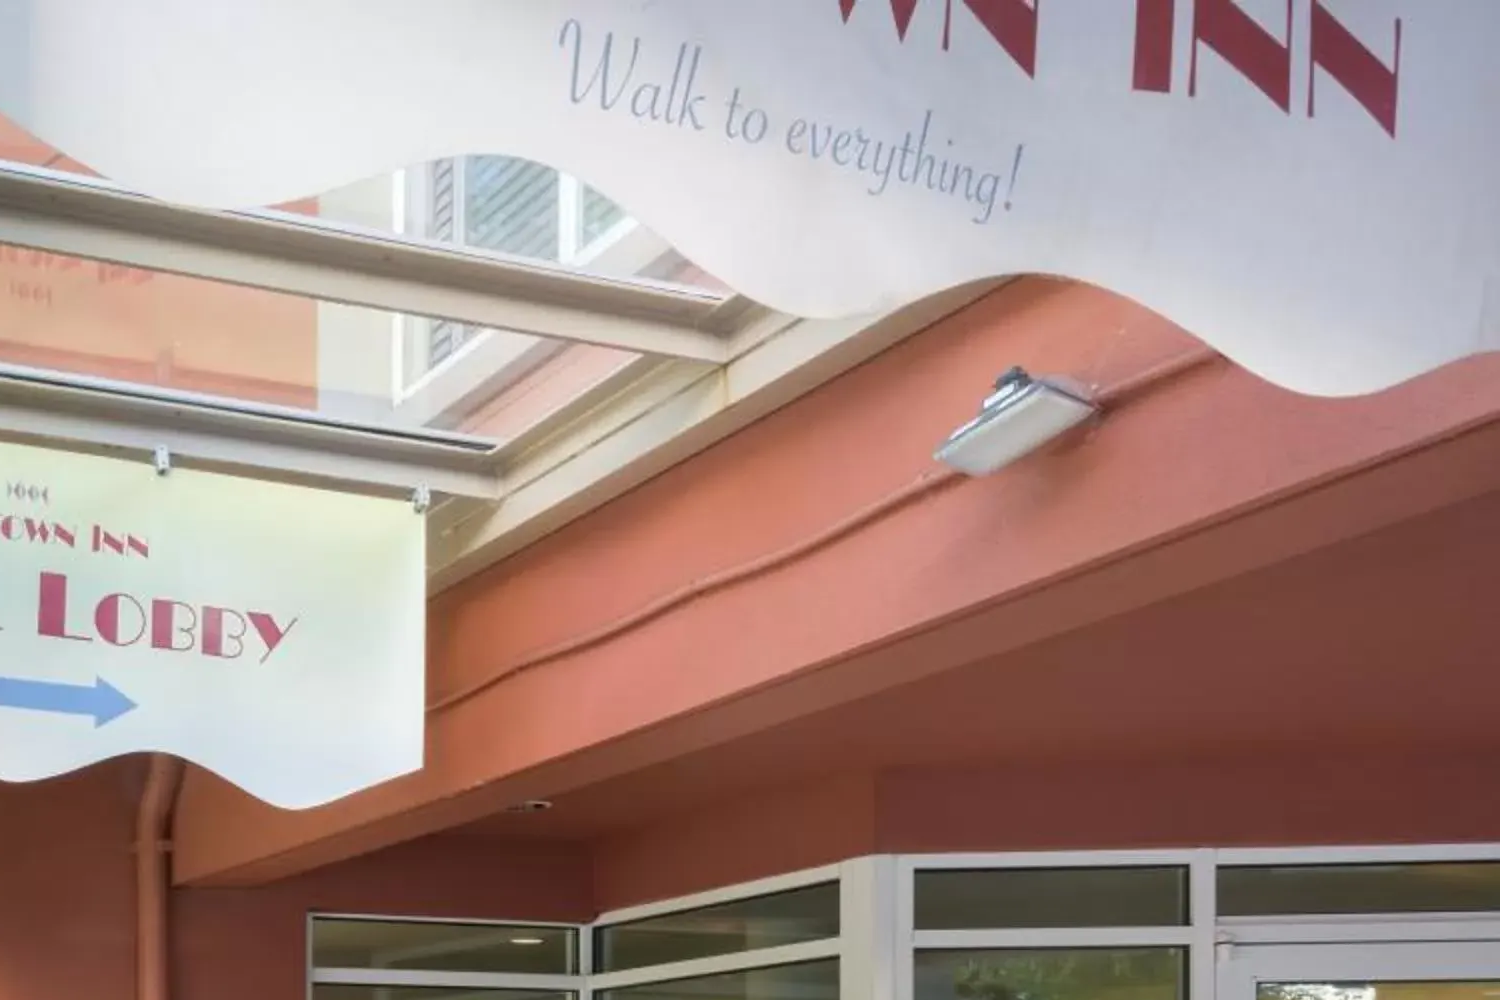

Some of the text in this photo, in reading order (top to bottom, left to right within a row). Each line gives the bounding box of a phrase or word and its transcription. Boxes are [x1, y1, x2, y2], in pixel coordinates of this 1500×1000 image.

[558, 18, 1027, 225] Walk to everything!
[1132, 0, 1402, 139] INN
[92, 524, 150, 559] INN
[37, 571, 298, 665] LOBBY
